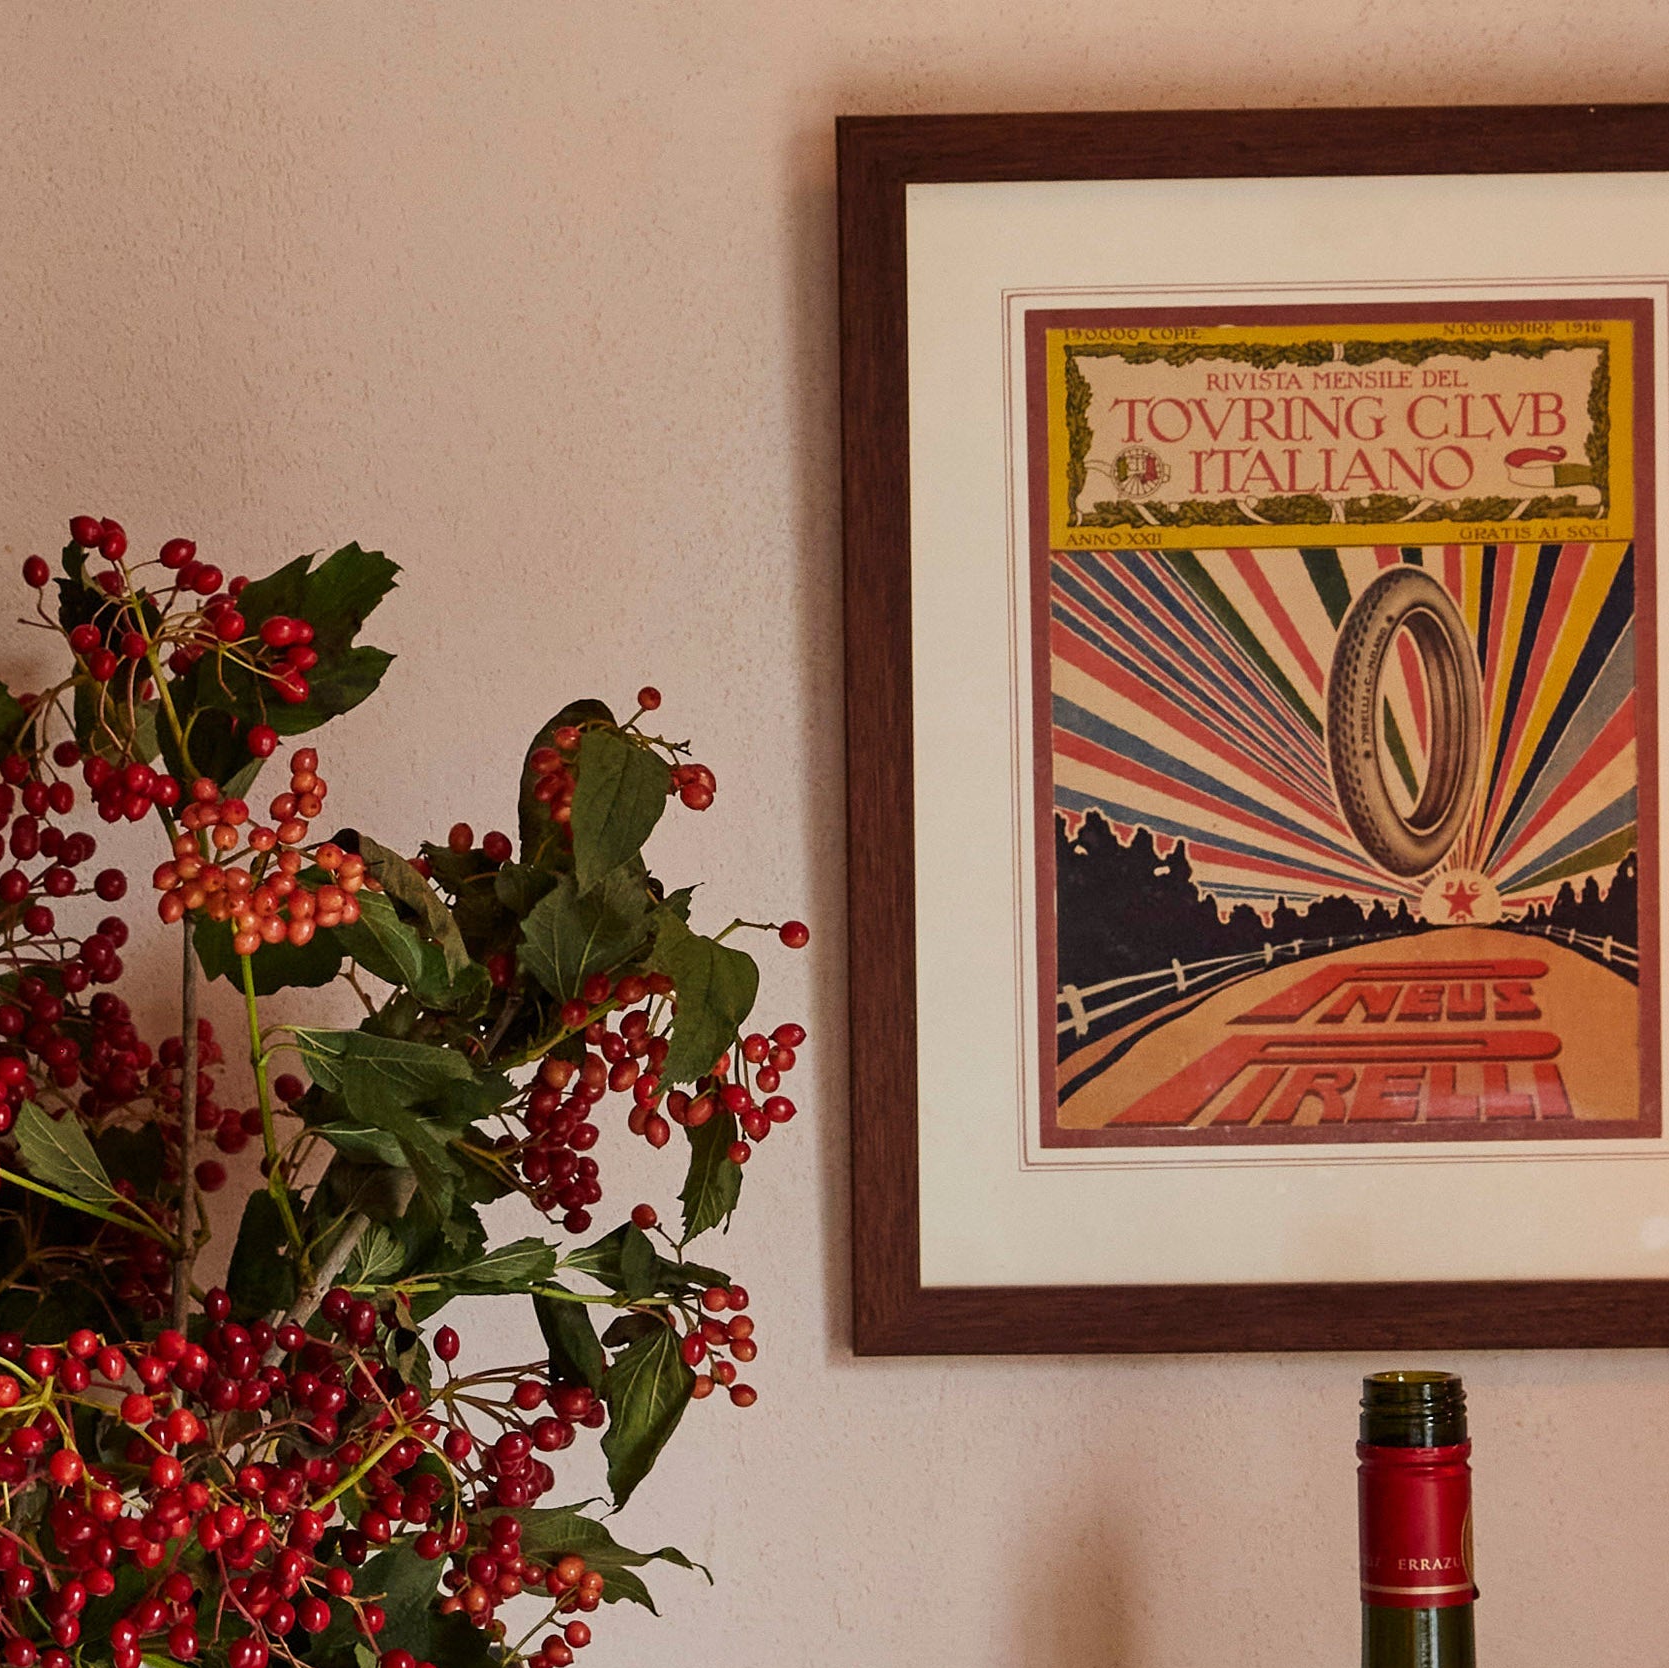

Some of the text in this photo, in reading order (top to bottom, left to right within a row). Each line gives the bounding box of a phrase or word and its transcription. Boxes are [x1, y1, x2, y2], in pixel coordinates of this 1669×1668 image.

[1149, 327, 1202, 340] COPIE
[1564, 320, 1603, 334] 1916
[1205, 369, 1469, 392] RIVISTA MENSILE DEL
[1108, 392, 1568, 444] TOVRING CLVB
[1188, 445, 1475, 495] ITALIANO
[1066, 532, 1162, 546] ANNO XXII
[1459, 525, 1610, 541] GRATIS AI SOCI
[1445, 881, 1480, 893] P C
[1225, 958, 1550, 1025] PNEUS
[1103, 1030, 1577, 1128] PIRELLI
